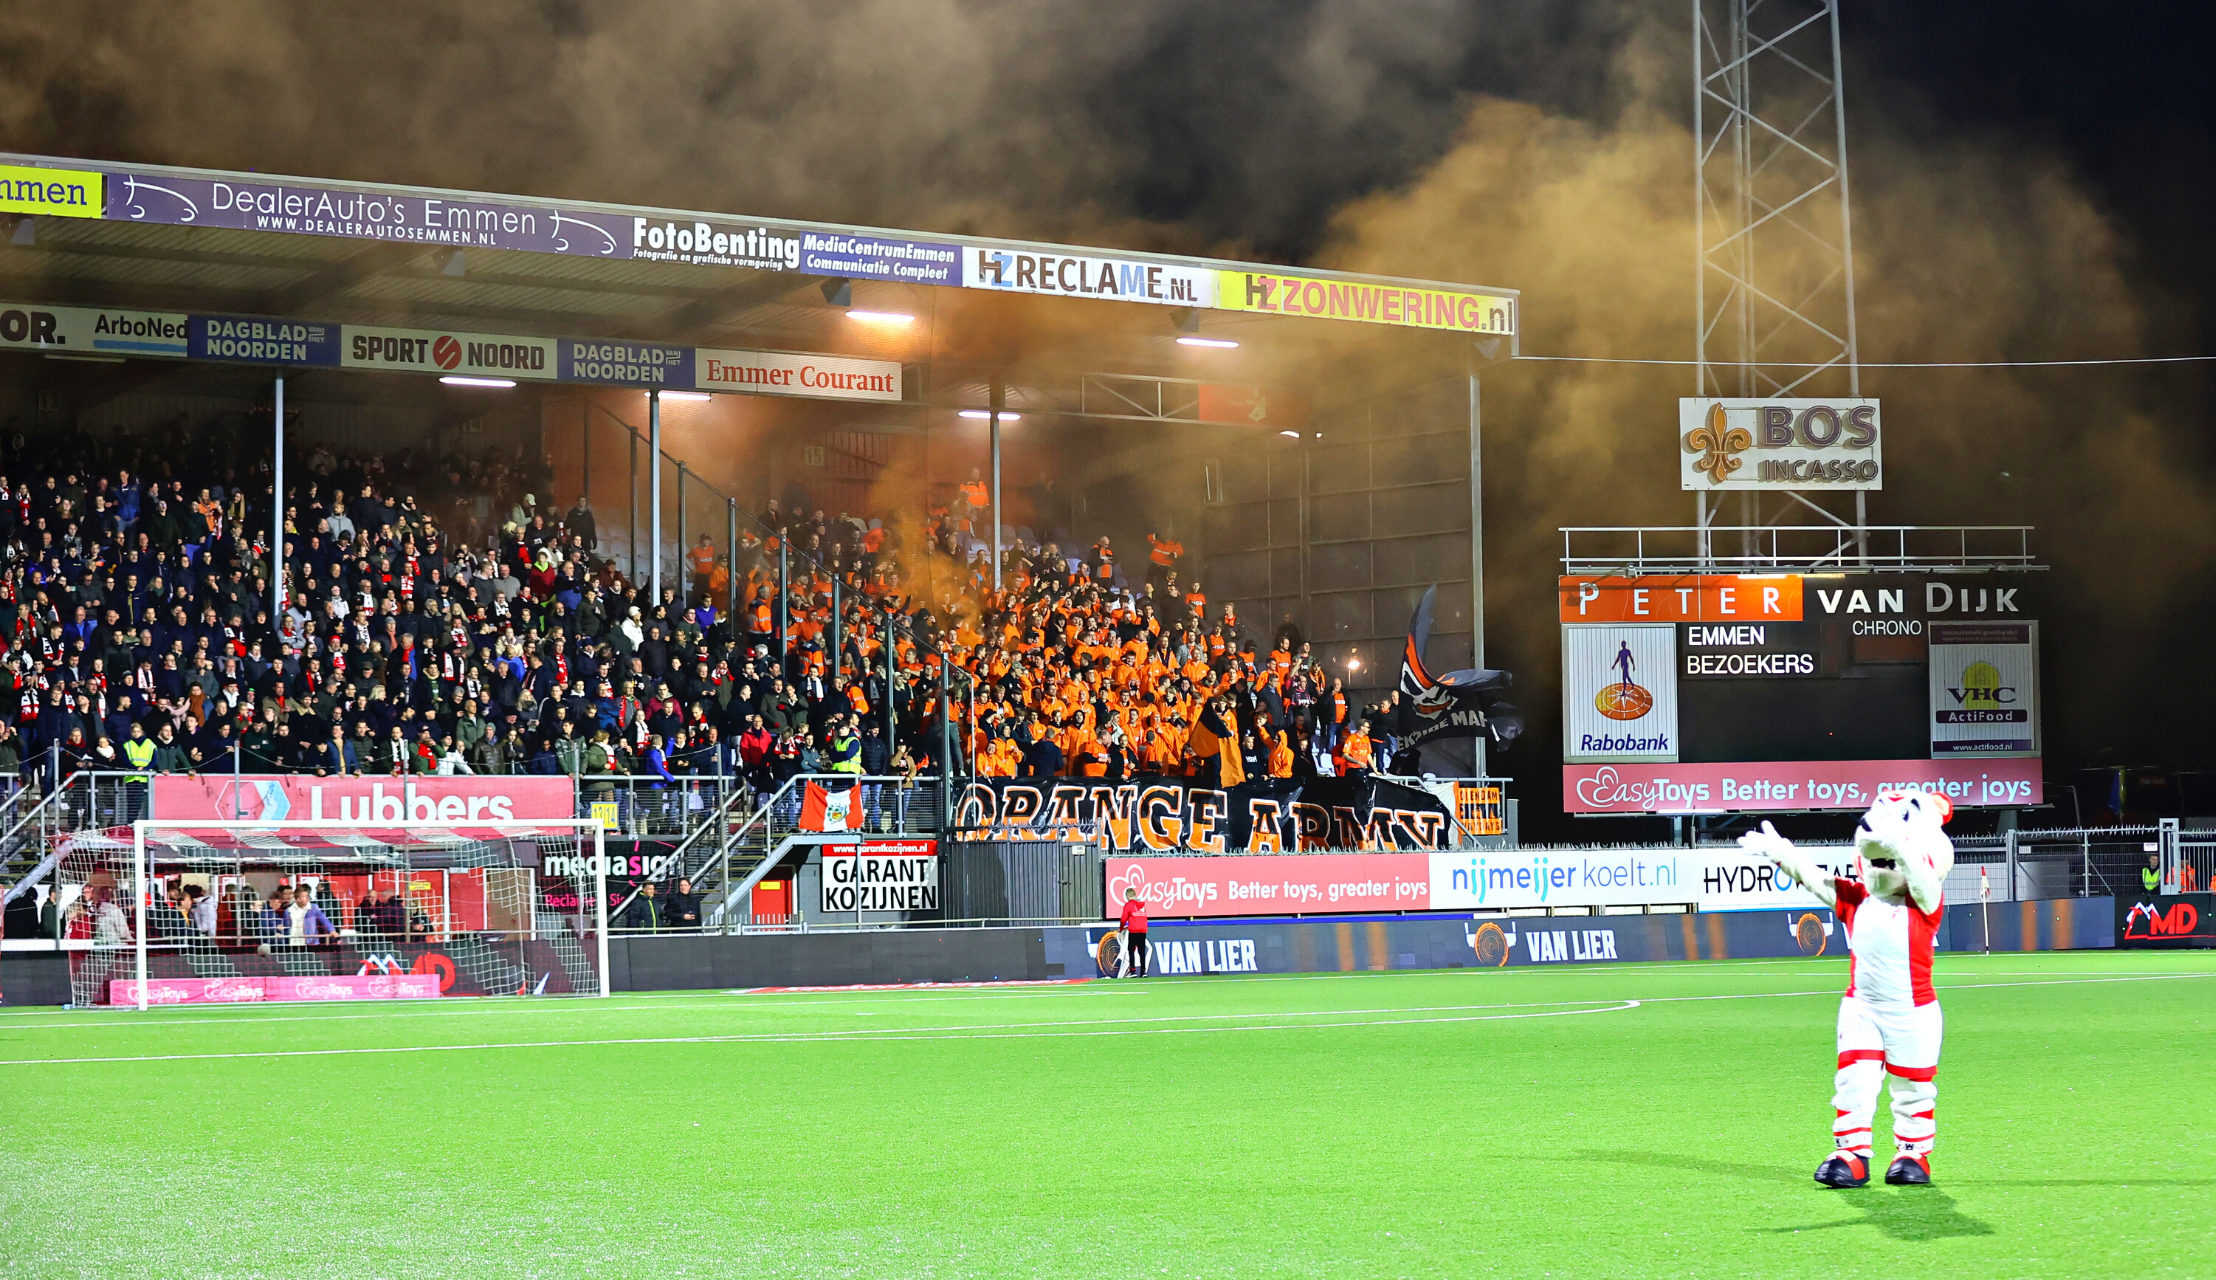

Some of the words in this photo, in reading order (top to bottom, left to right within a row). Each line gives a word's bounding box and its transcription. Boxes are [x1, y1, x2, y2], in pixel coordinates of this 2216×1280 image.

[213, 183, 404, 224] DealerAuto's
[425, 200, 536, 234] Emmen
[257, 215, 497, 245] WWW.DEALERAUTOSEMMEN.NL
[633, 217, 800, 269] FotoBenting
[802, 234, 955, 263] MediaCentrumEmmen
[633, 248, 678, 263] Fotografie
[680, 253, 691, 262] en
[692, 253, 732, 266] grafische
[734, 258, 783, 271] vormgeving
[807, 254, 890, 275] Communicatie
[894, 262, 948, 281] Compleet
[1283, 279, 1513, 333] ZONWERING.nl
[94, 314, 188, 339] ArboNed
[207, 320, 308, 342] DAGBLAD
[207, 340, 307, 361] NOORDEN
[353, 336, 429, 364] SPORT
[468, 342, 545, 371] NOORD
[574, 344, 665, 364] DAGBLAD
[574, 362, 665, 383] NOORDEN
[706, 359, 794, 386] Emmer
[799, 365, 895, 393] Courant
[1764, 405, 1877, 447] BOS
[1765, 459, 1879, 481] INCASSO
[1579, 582, 1782, 616] PETER
[1816, 589, 1904, 614] VAN
[1926, 582, 2020, 613] DIJK
[1688, 626, 1765, 646] EMMEN
[1852, 620, 1922, 636] CHRONO
[1687, 654, 1815, 675] BEZOEKERS
[1946, 687, 2017, 704] VHC
[1948, 711, 2013, 722] ActiFood
[1581, 733, 1669, 752] Rabobank
[1952, 743, 2013, 751] www.actifood.nl
[311, 782, 514, 821] Lubbers
[1590, 769, 1710, 809] EasyToys
[1722, 778, 1799, 801] Better
[1807, 778, 1868, 803] toys,
[1981, 773, 2032, 803] joys
[953, 784, 1228, 852] ORANGE
[1244, 798, 1447, 852] ARMY
[833, 843, 928, 855] www.arantkozijnen.nl
[832, 859, 929, 883] GARANT
[1452, 857, 1577, 904] nijmeijer
[1583, 857, 1677, 887] koelt.nl
[826, 886, 937, 910] KOZIJNEN
[1130, 870, 1218, 909] EasyToys
[1229, 880, 1281, 900] Better
[1284, 880, 1323, 903] toys,
[1329, 879, 1390, 903] greater
[1394, 876, 1428, 901] joys
[1154, 940, 1202, 974] VAN
[1206, 939, 1258, 972] LIER
[1526, 931, 1569, 962] VAN
[1571, 929, 1619, 961] LIER
[133, 984, 188, 1003] asyToys
